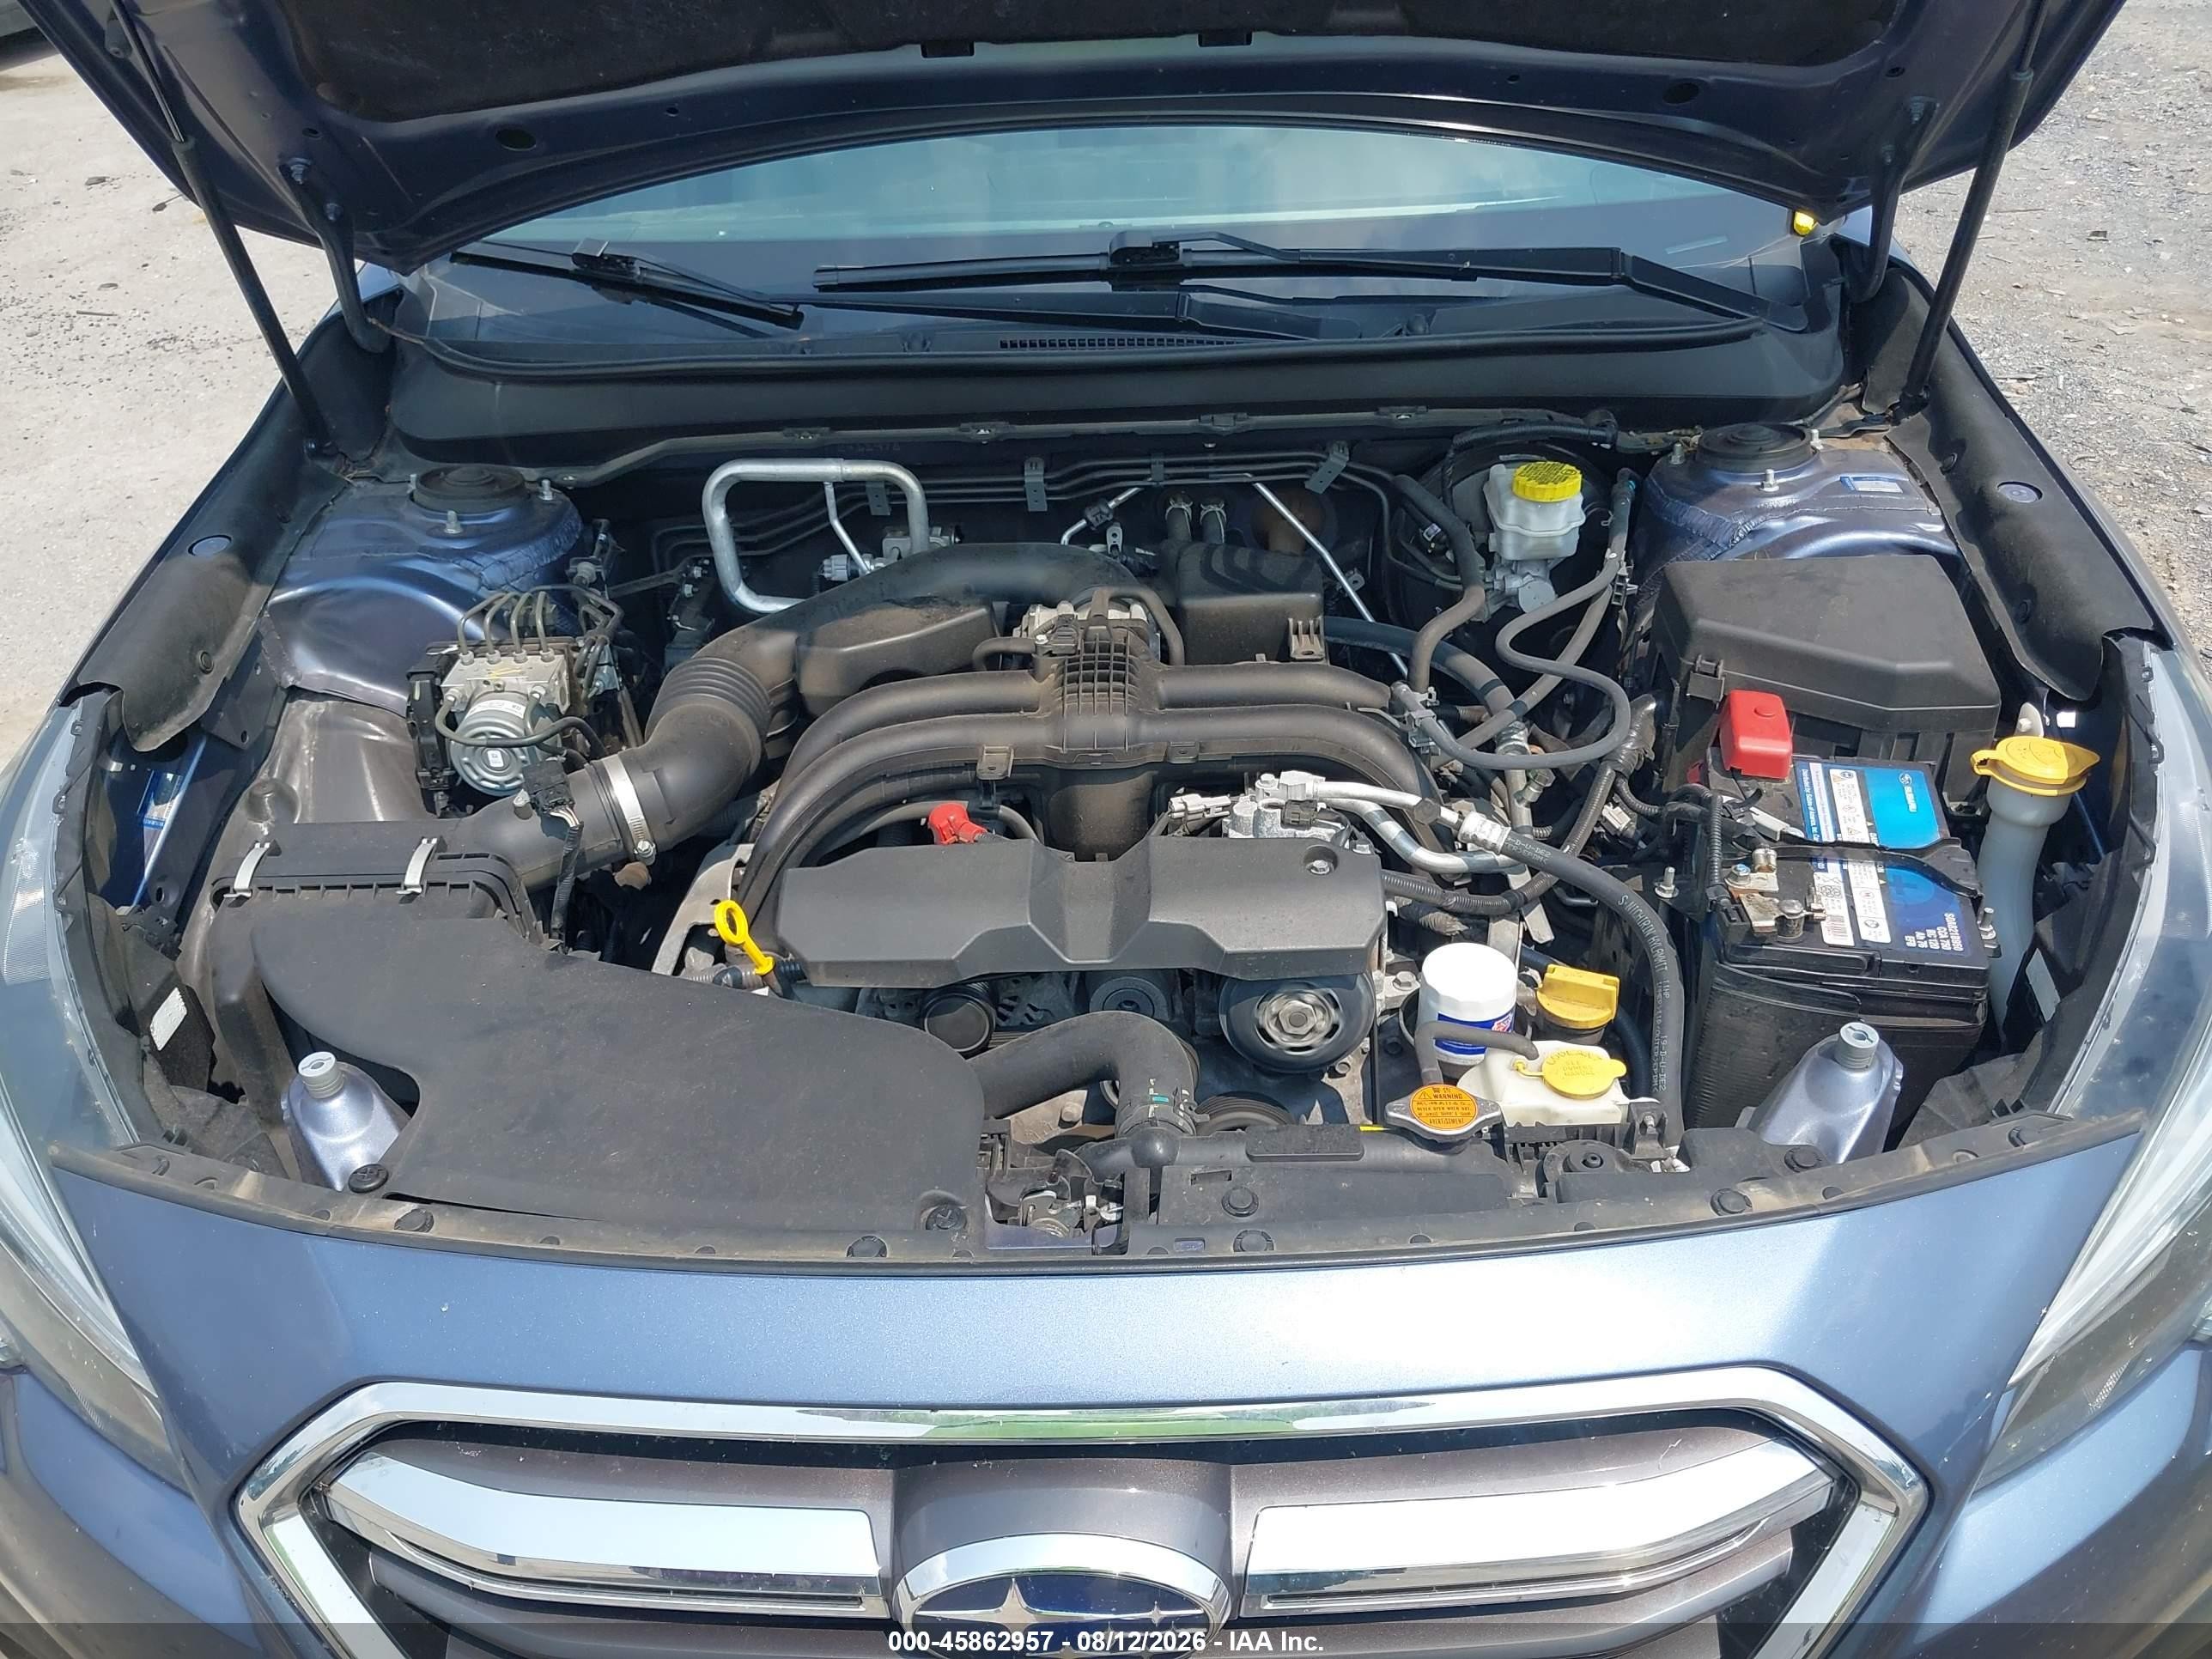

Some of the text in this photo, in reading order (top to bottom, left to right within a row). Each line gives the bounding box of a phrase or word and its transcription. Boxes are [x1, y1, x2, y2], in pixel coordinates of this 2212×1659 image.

[1904, 785, 1917, 813] SUBARU
[1905, 935, 1917, 947] EFB
[1915, 931, 1926, 940] Ah
[1926, 929, 1941, 950] RC 120
[1936, 927, 1952, 951] CCA 750
